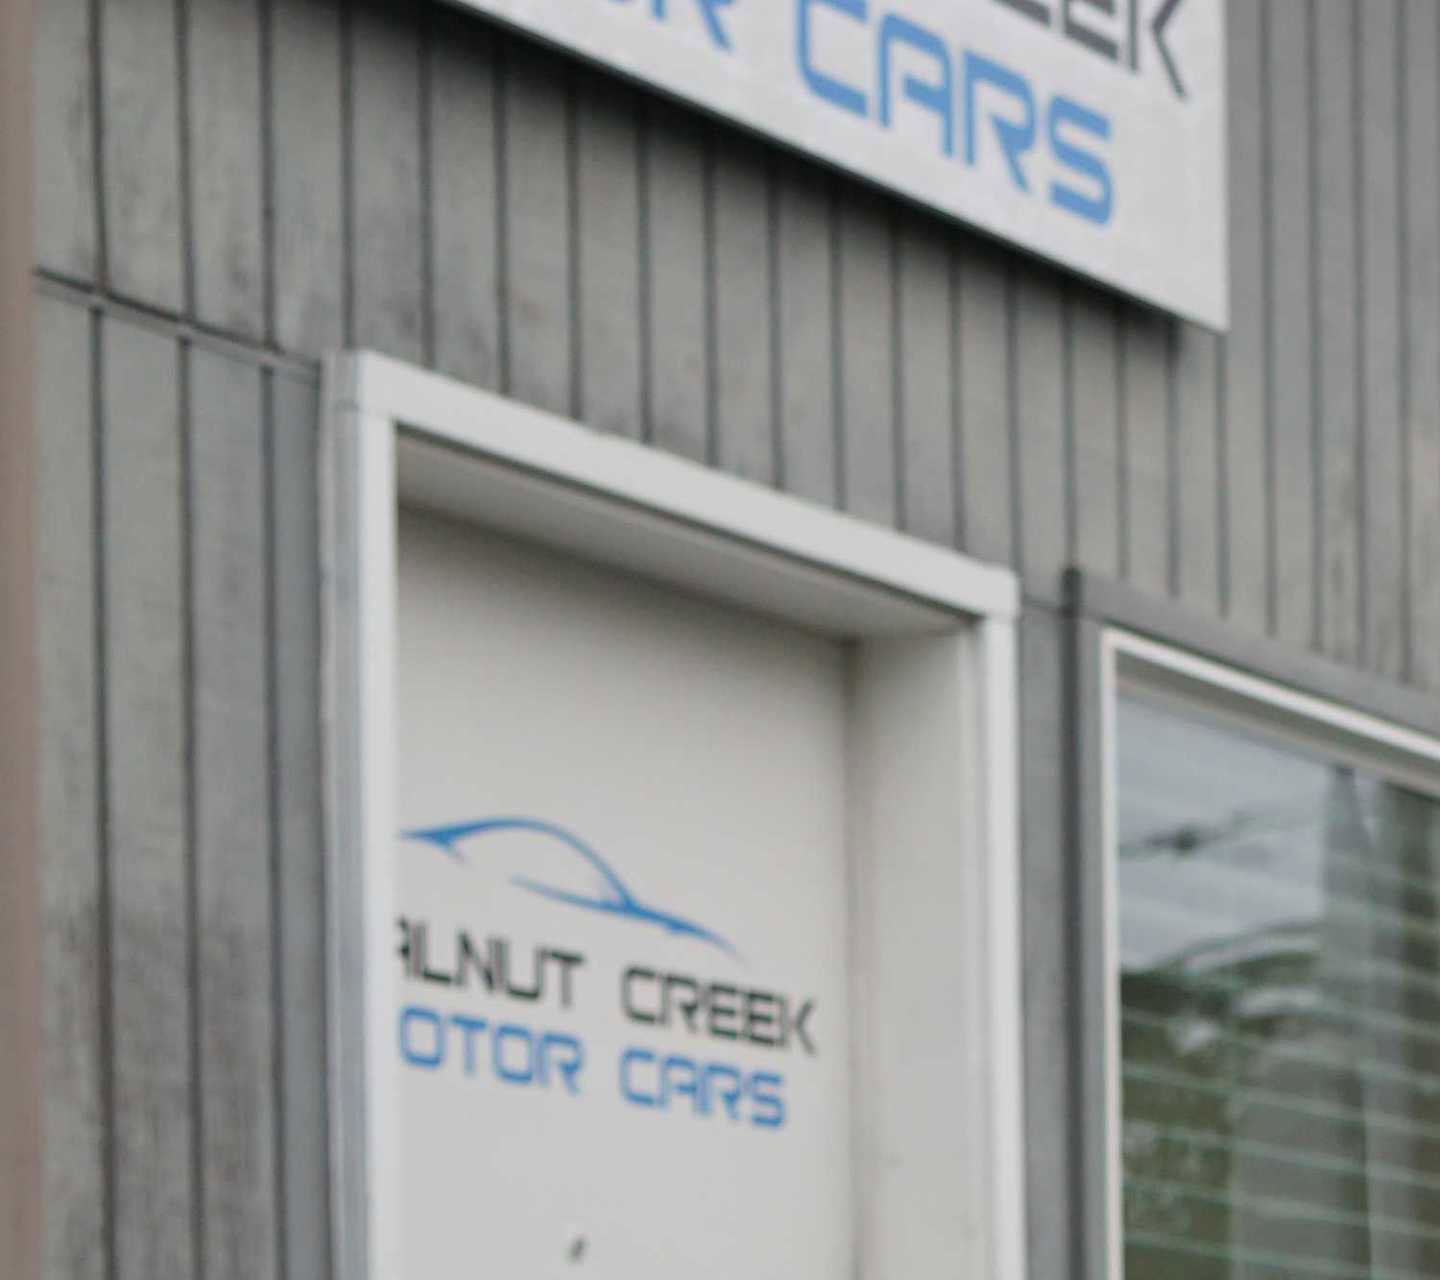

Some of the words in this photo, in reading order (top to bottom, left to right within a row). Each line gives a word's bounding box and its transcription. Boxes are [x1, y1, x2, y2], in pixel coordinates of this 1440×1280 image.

[795, 0, 1115, 227] CARS
[398, 916, 586, 1010] LNUT
[622, 964, 818, 1055] CREEK
[399, 1005, 584, 1097] OTOR
[621, 1046, 787, 1130] CARS
